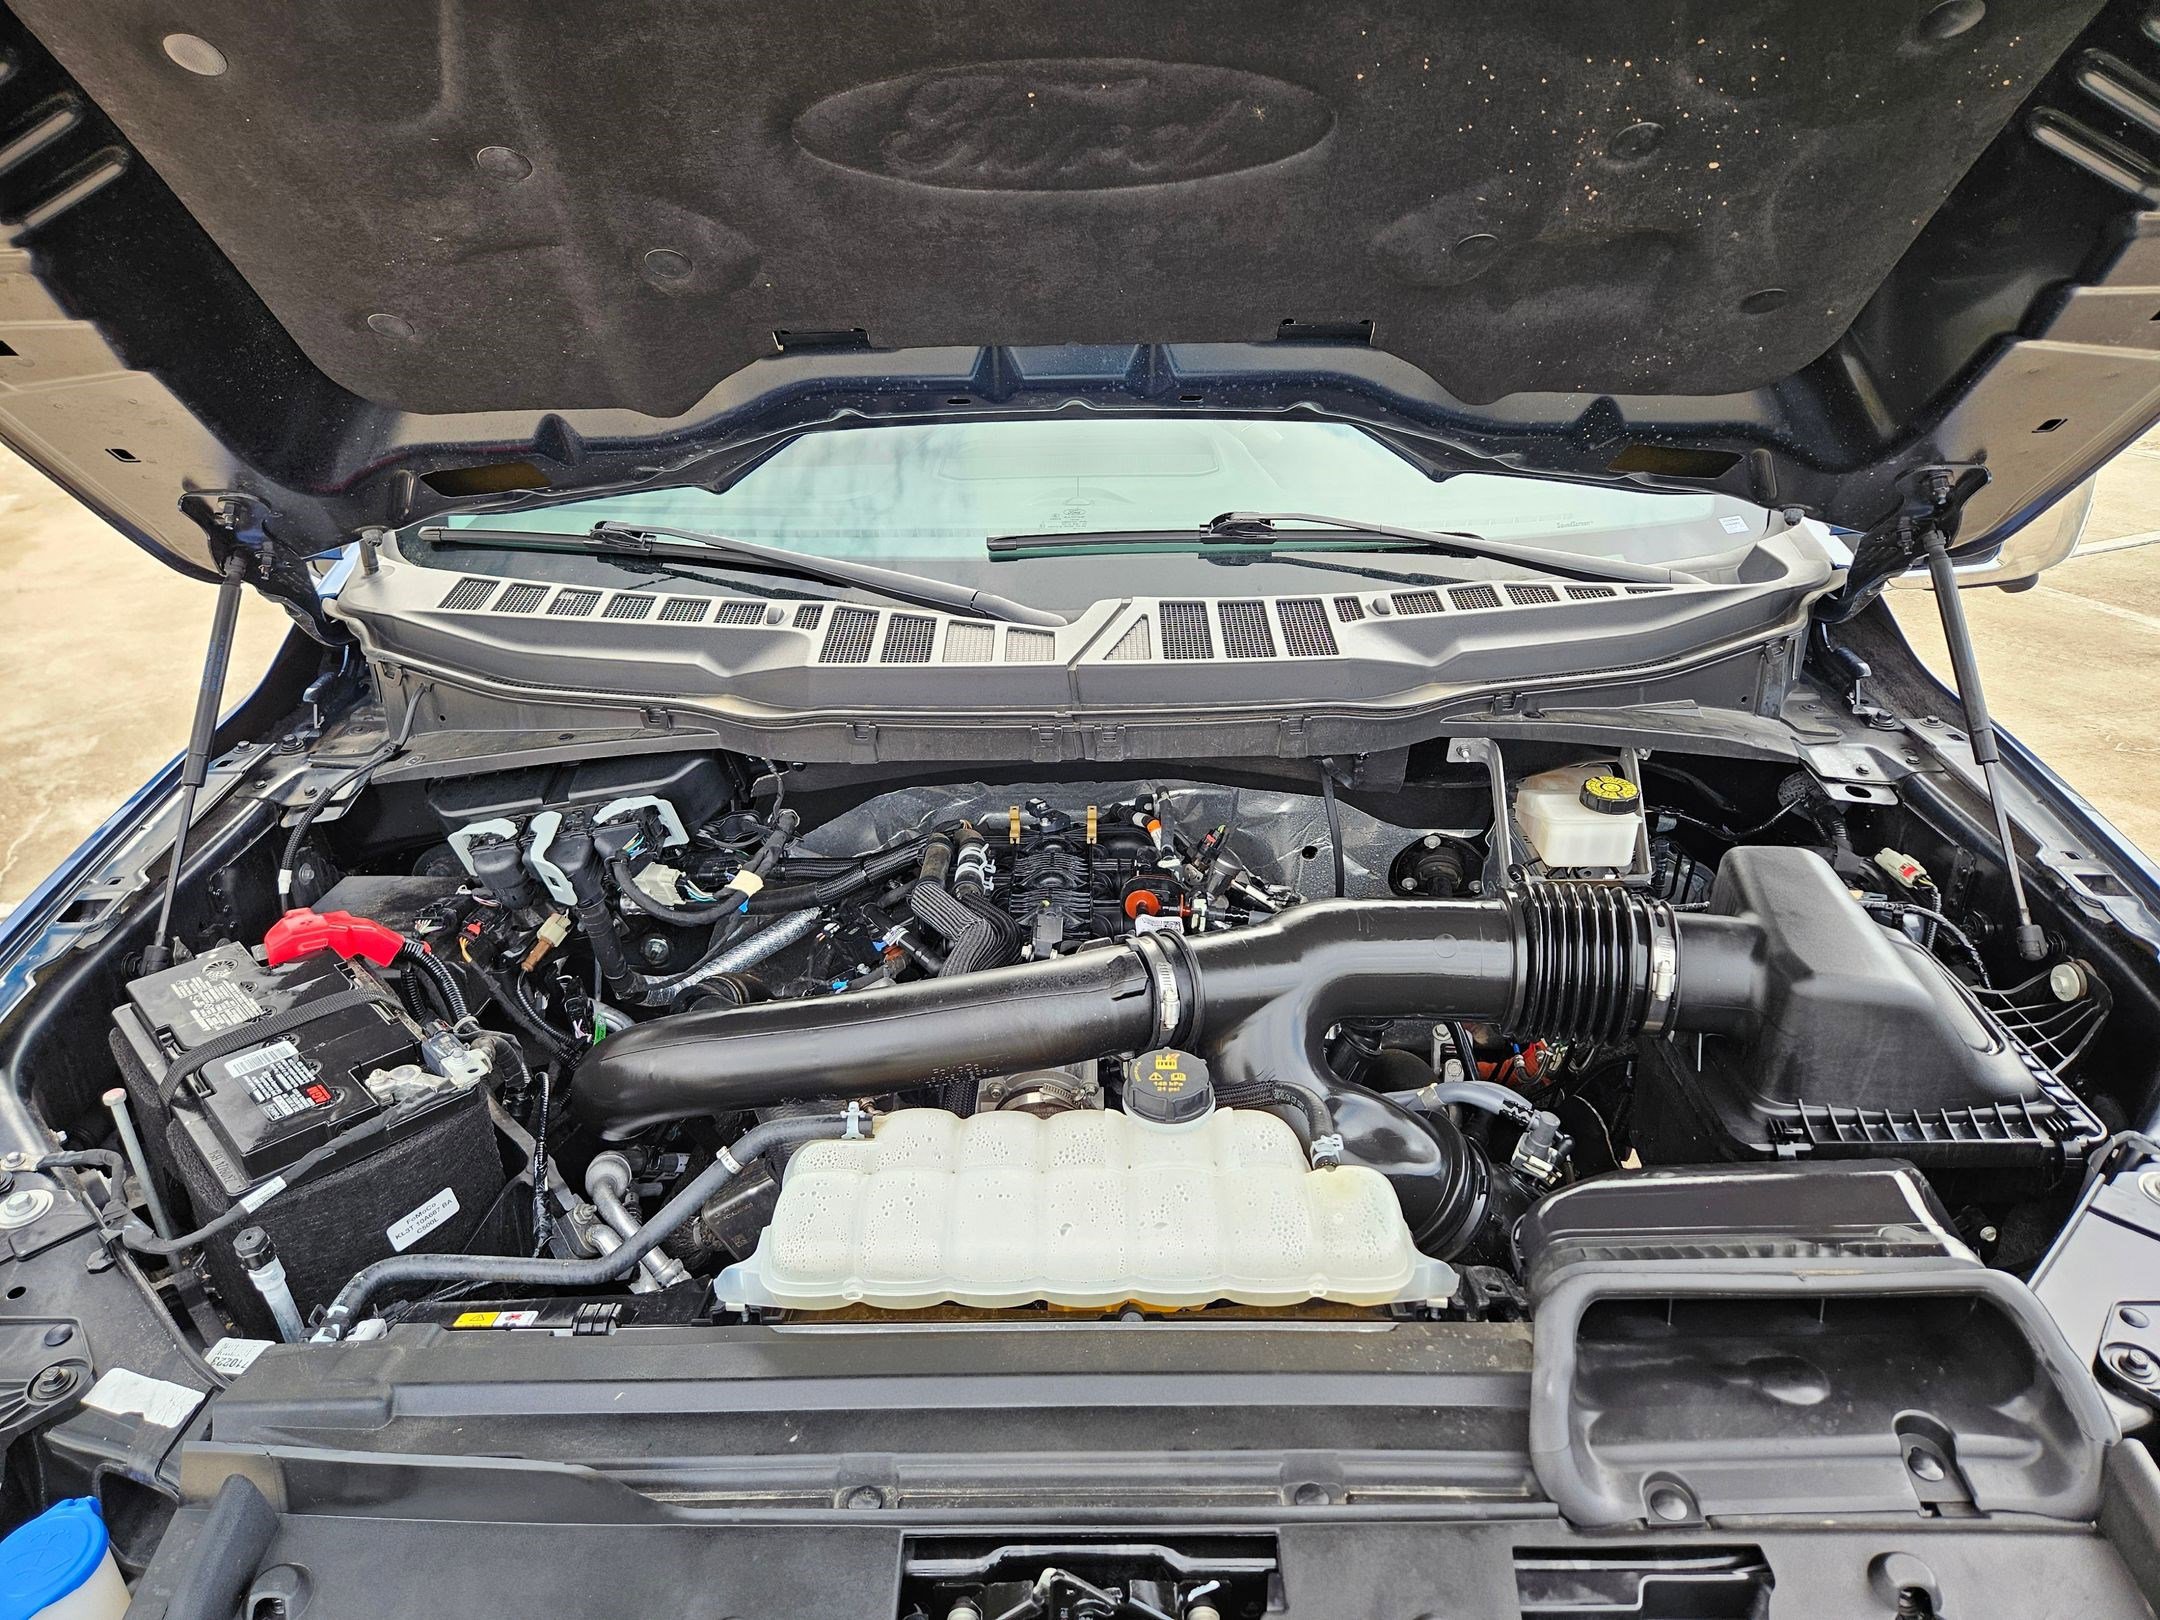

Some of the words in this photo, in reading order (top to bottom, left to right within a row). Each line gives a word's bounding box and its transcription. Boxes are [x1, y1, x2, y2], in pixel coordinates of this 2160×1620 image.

[395, 1225, 414, 1240] KL3T
[441, 1199, 453, 1209] BA
[406, 1202, 437, 1225] FoMoCo
[416, 1217, 440, 1234] C500L
[211, 1356, 250, 1369] 710223
